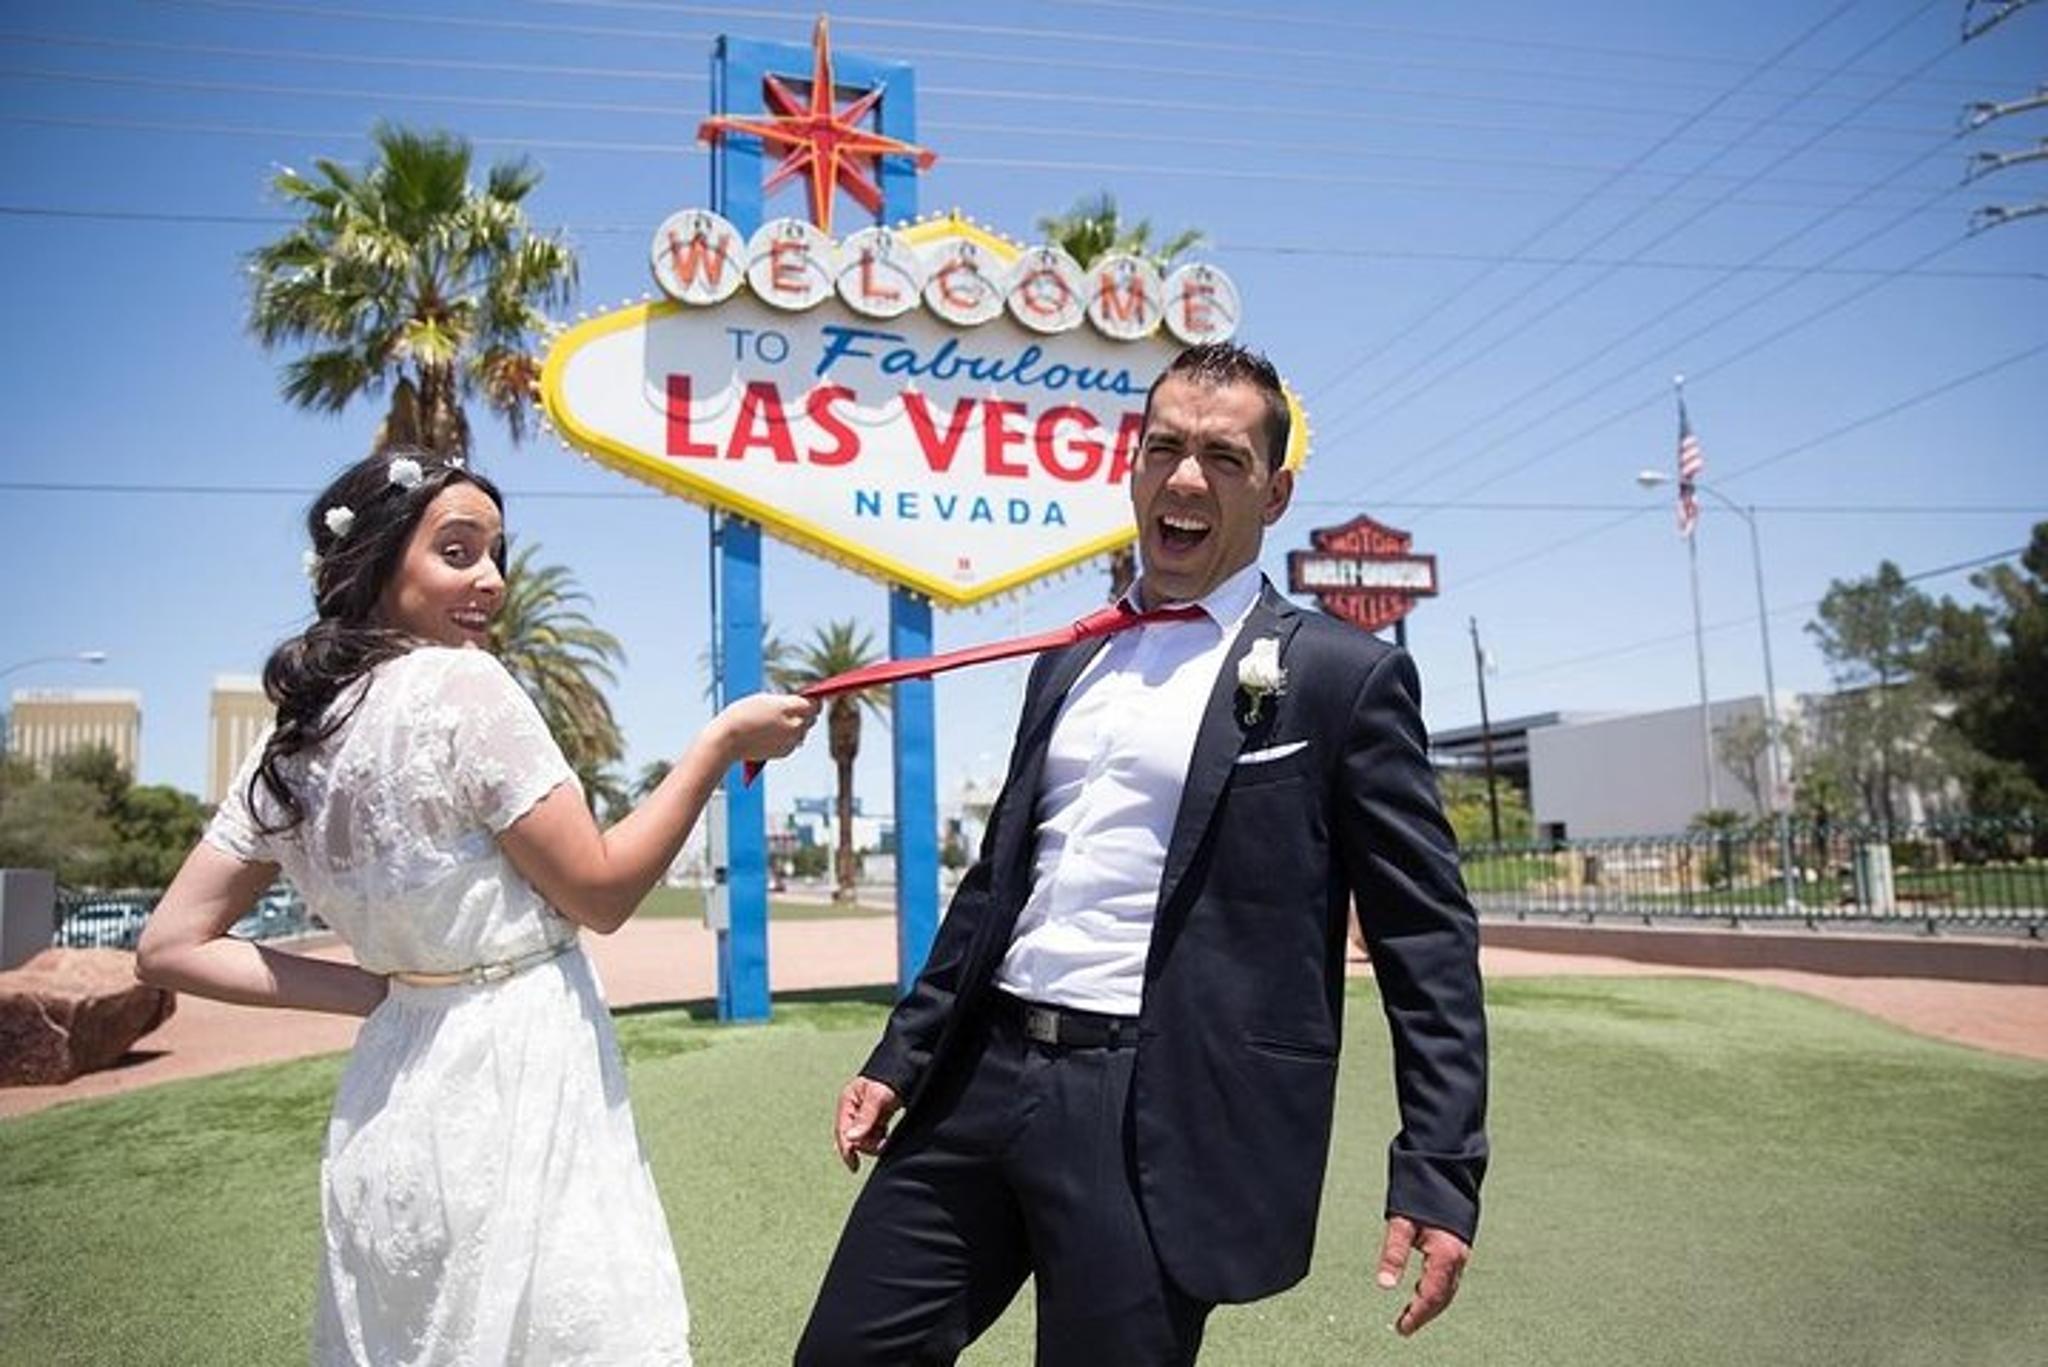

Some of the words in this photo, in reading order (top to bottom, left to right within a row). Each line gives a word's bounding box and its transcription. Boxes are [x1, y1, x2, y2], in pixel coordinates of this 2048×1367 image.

[668, 229, 1216, 332] WELCOME
[727, 327, 791, 364] TO
[815, 325, 1149, 395] Fabulous
[666, 374, 861, 467] LAS
[902, 390, 1143, 486] VEG
[855, 490, 1067, 526] NEVADA
